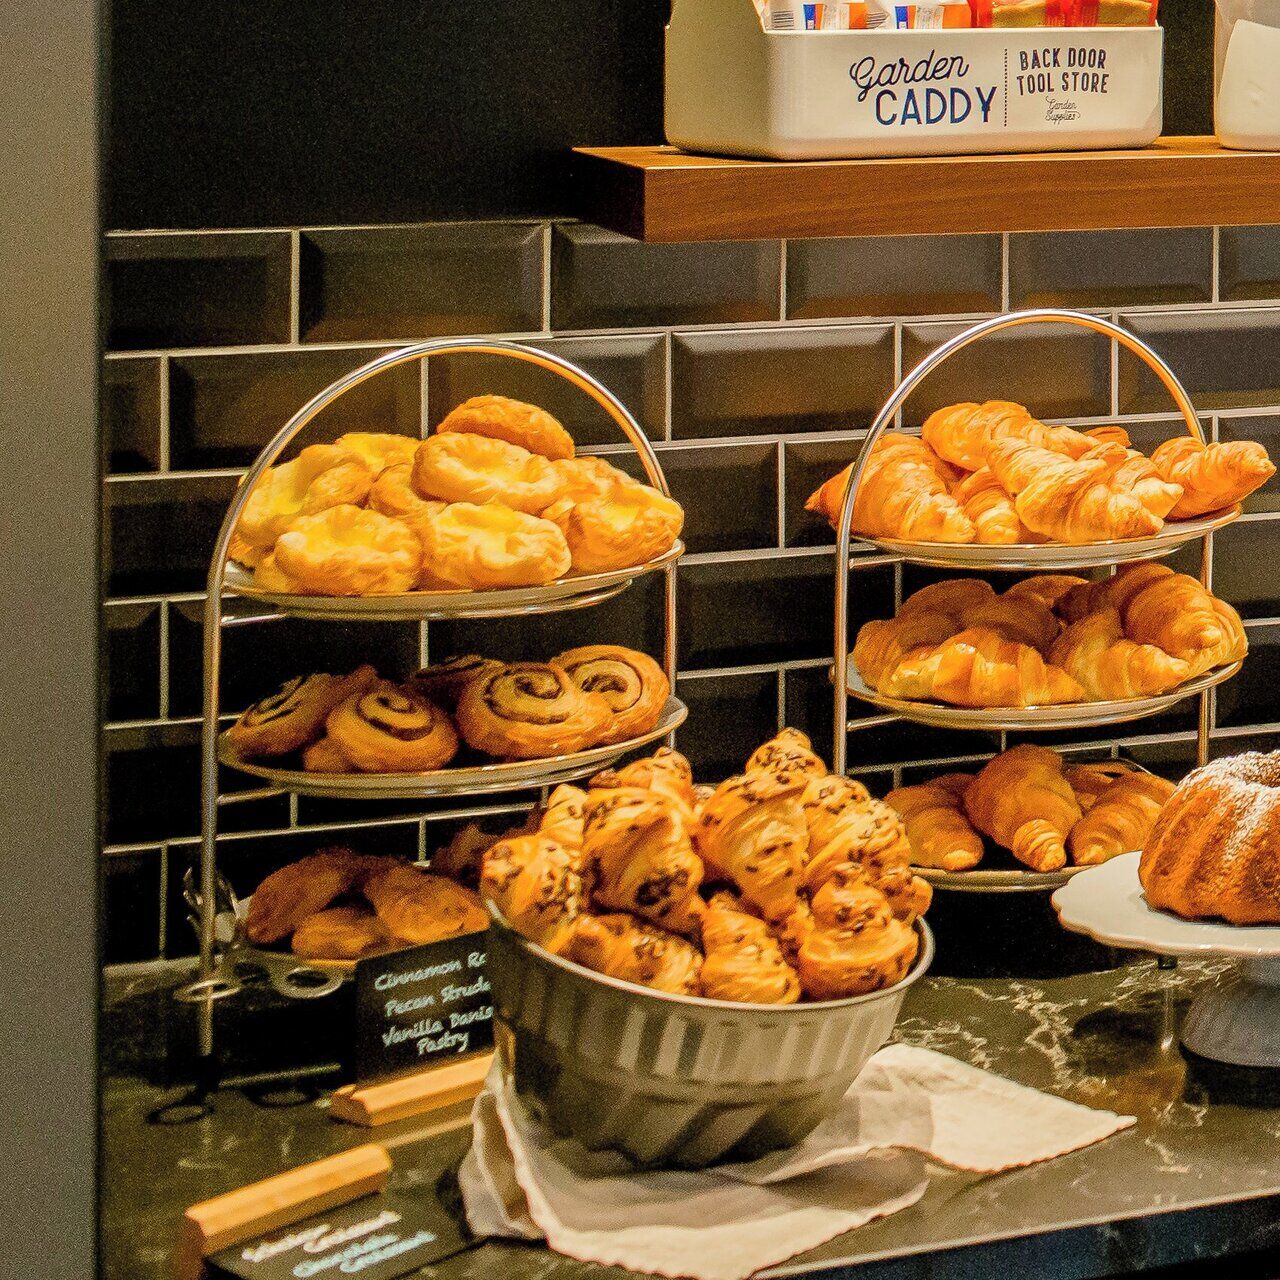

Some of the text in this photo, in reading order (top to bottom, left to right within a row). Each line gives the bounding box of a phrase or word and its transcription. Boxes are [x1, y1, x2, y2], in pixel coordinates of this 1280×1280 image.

[1019, 47, 1107, 71] BACK DOOR
[850, 49, 970, 102] Garden
[1016, 71, 1110, 96] TOOL STORE
[875, 86, 998, 126] CADDY
[373, 958, 463, 991] Cinnamon
[383, 993, 436, 1018] Pecan
[381, 1018, 445, 1048] Vanilla
[416, 1031, 470, 1056] Pastry
